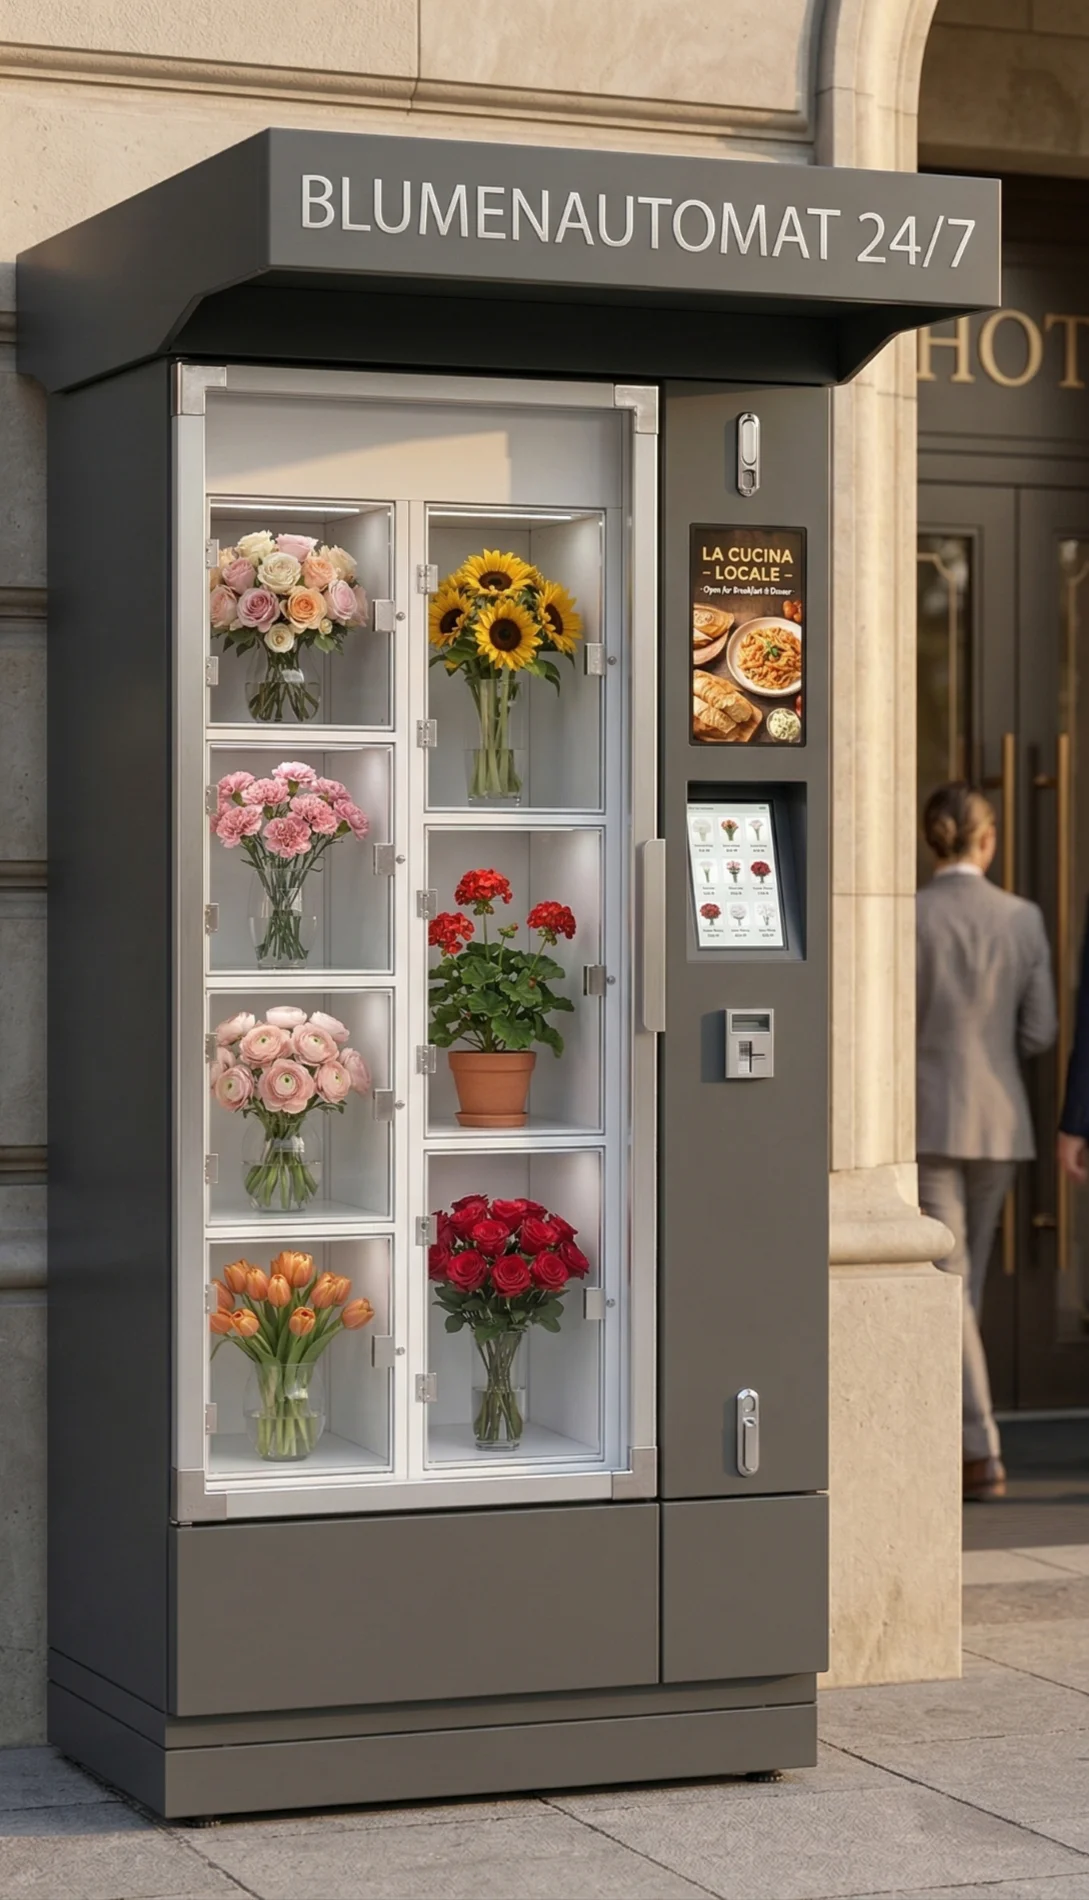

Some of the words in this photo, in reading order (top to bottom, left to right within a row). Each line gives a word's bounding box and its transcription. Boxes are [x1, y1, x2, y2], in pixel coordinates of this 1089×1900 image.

[300, 173, 842, 263] BLUMENAUTOMAT
[856, 211, 976, 268] 24/7
[917, 308, 1089, 389] HOT
[702, 546, 724, 561] LA
[728, 547, 794, 564] CUCINA
[715, 565, 780, 582] LOCALE
[703, 585, 721, 596] Open
[721, 585, 732, 595] for
